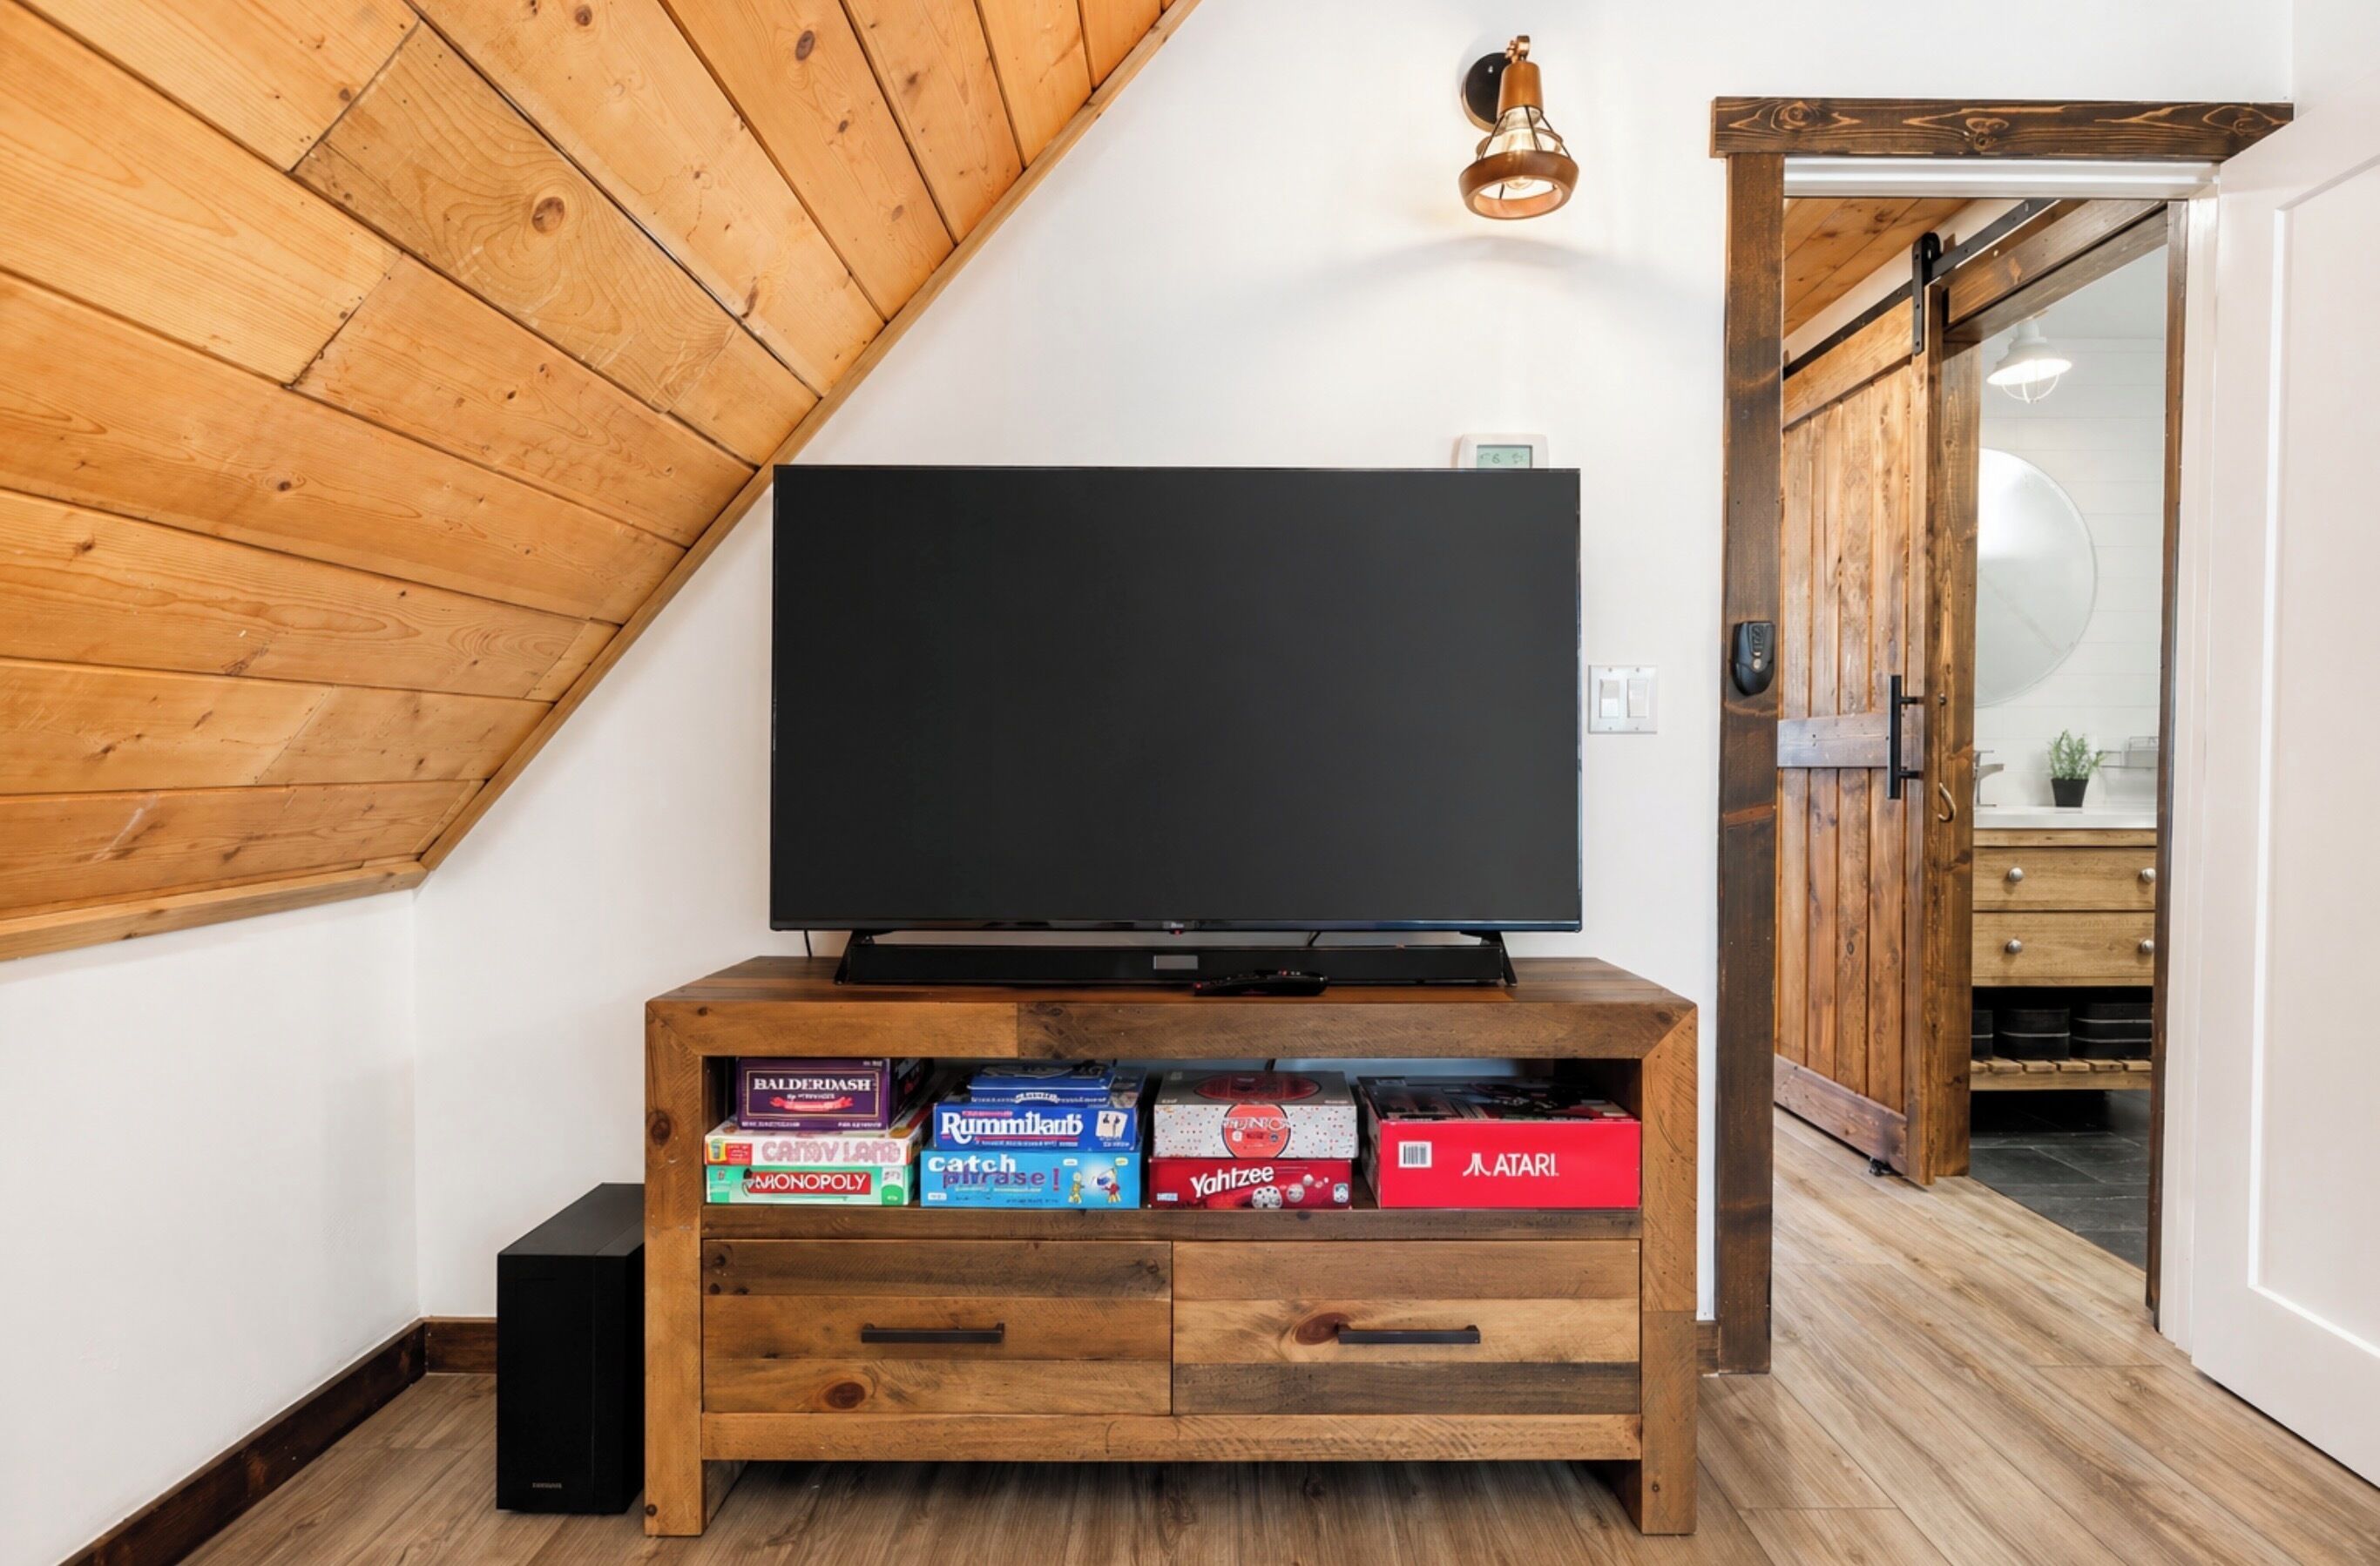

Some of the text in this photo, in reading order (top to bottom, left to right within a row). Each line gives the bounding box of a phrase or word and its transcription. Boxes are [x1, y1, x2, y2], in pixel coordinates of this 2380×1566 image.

[754, 1077, 871, 1091] BALDERDASH
[761, 1141, 840, 1163] CANDY
[928, 1153, 1017, 1173] catch
[1492, 1152, 1557, 1177] ATARI
[754, 1173, 867, 1191] MONOPOLY
[1189, 1165, 1275, 1198] Yahtzee
